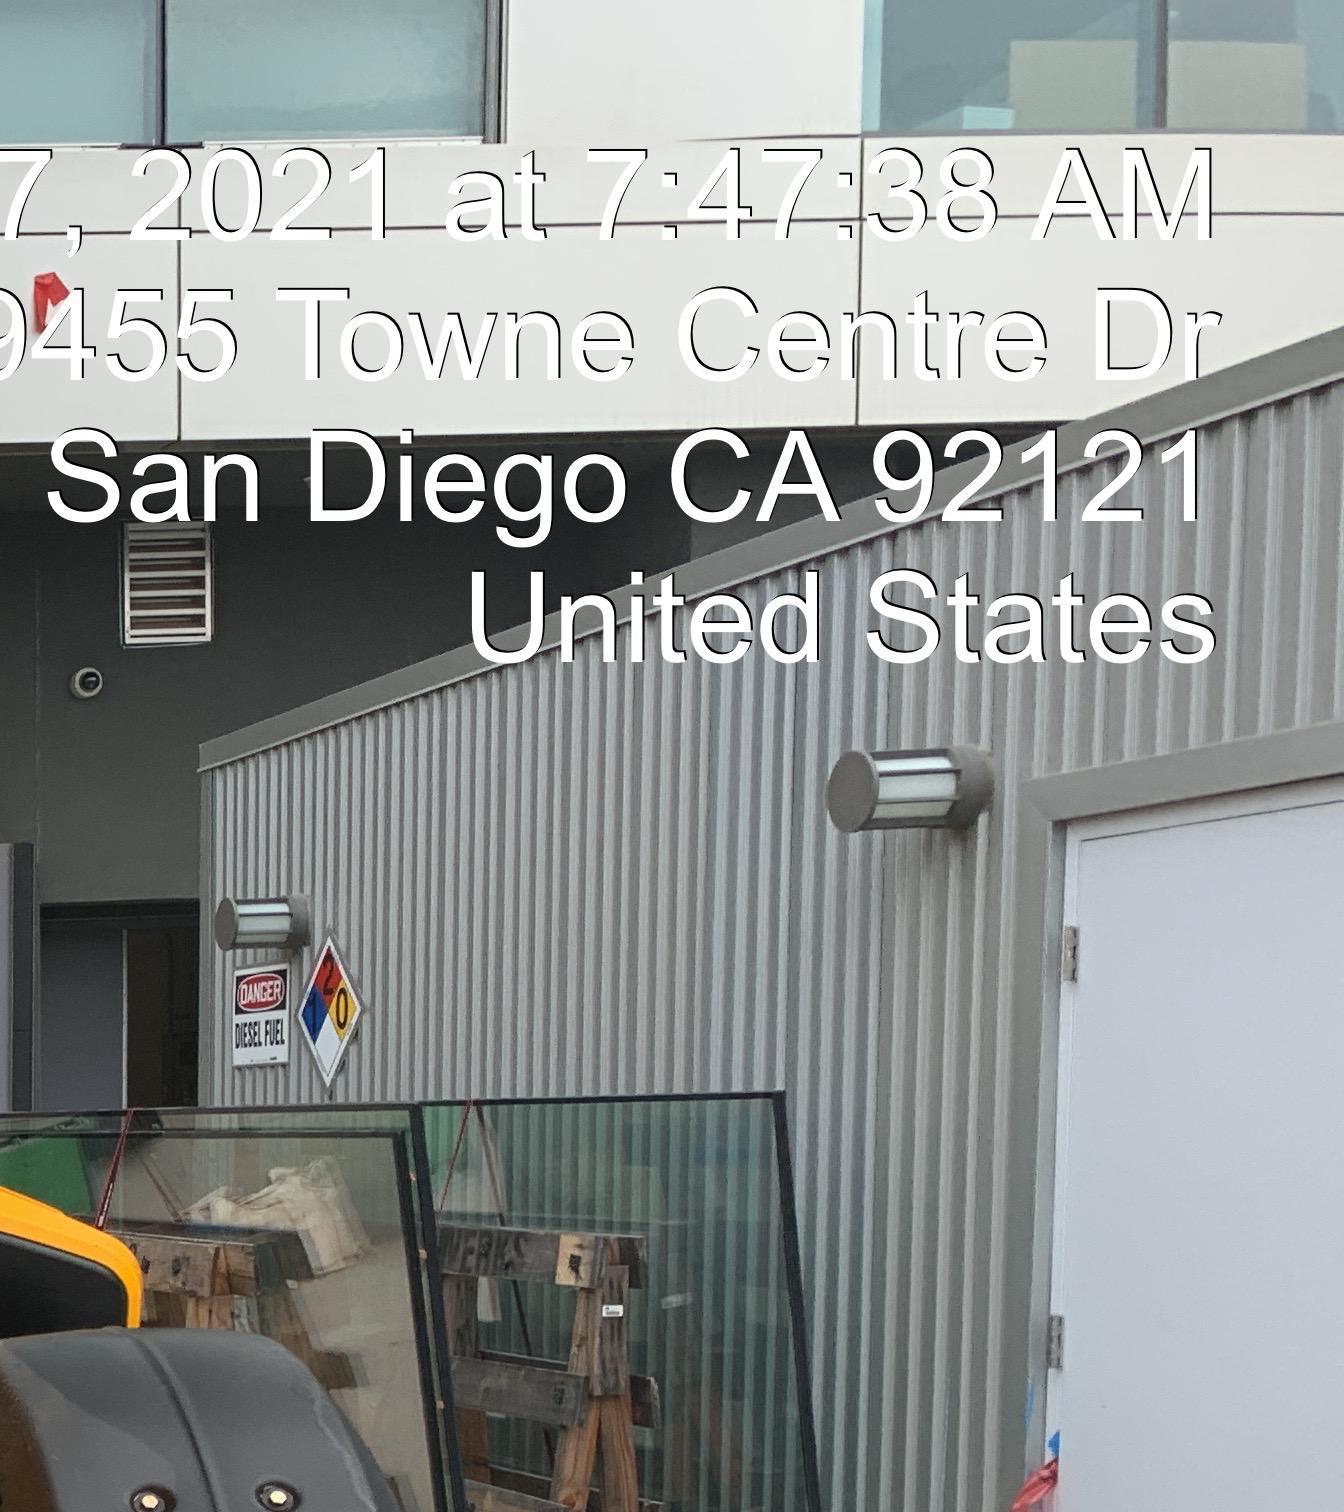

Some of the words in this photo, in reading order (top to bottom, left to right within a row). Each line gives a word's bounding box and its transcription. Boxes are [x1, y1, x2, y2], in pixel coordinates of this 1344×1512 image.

[239, 979, 283, 1006] DANGER
[335, 987, 349, 1031] 0
[234, 1020, 263, 1049] DIESEL
[264, 1018, 286, 1047] FUEL
